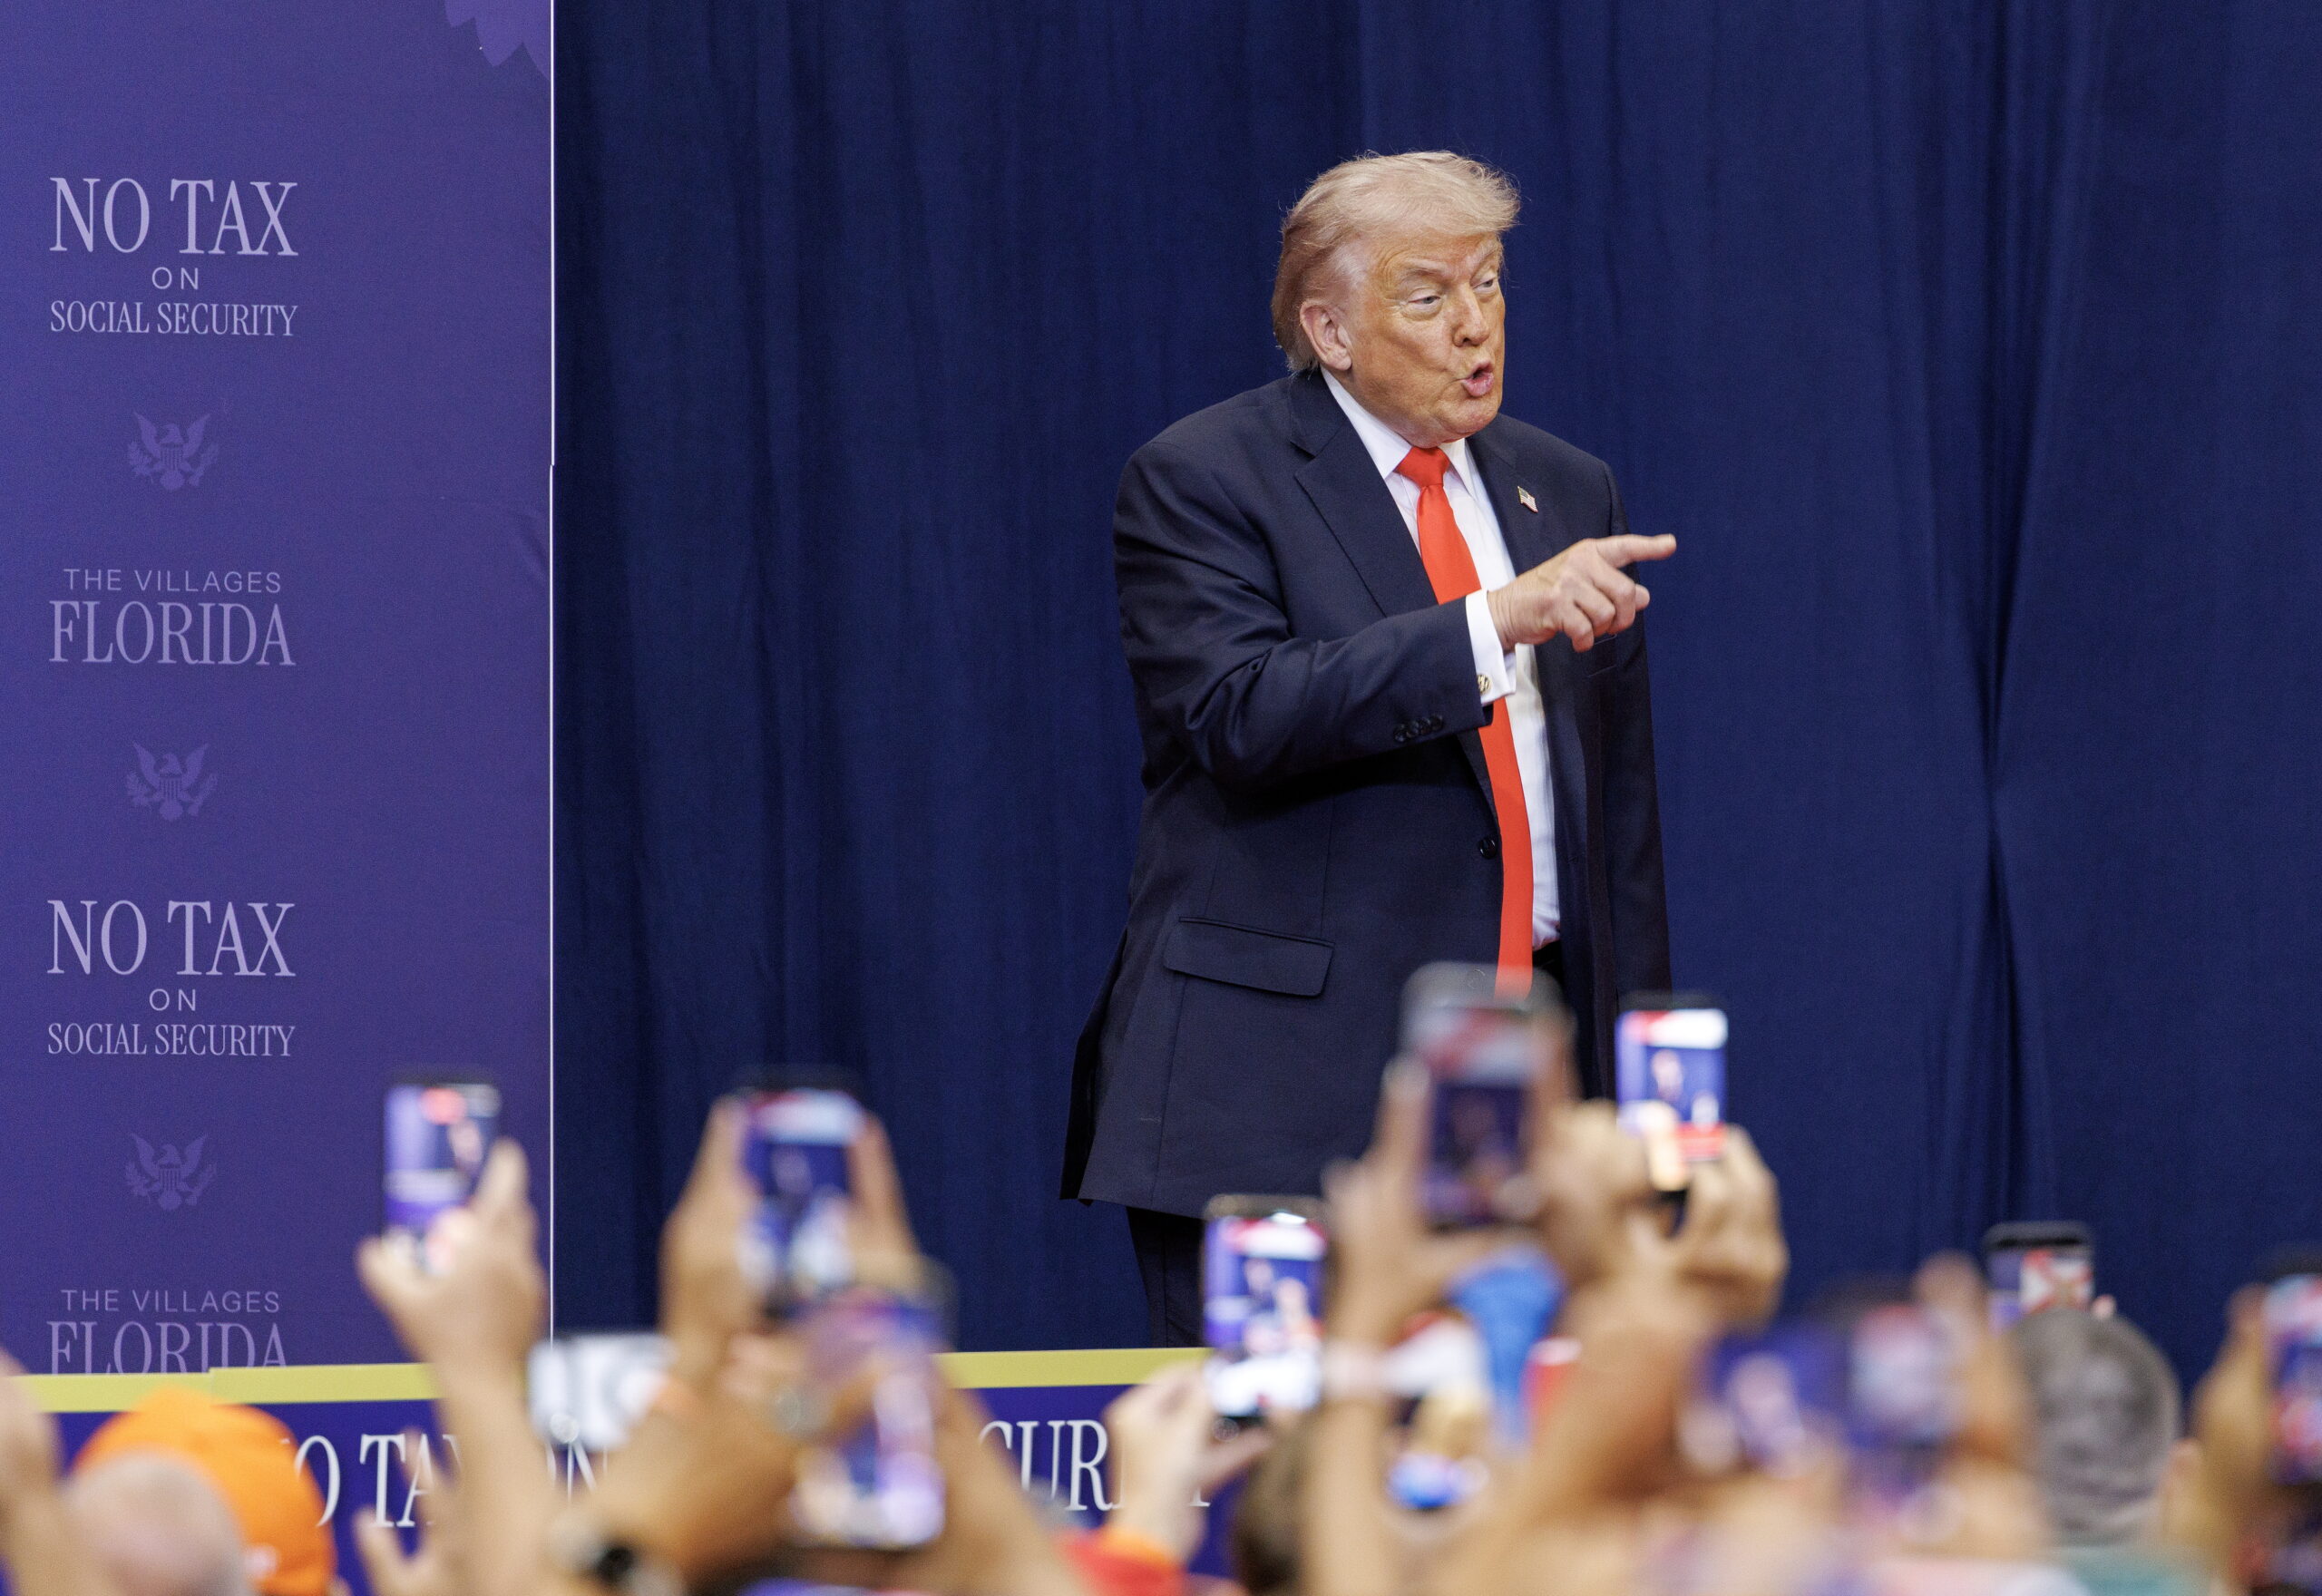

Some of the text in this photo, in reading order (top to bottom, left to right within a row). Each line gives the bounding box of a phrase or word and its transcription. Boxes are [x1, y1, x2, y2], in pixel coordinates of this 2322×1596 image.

[49, 177, 298, 256] NO TAX
[151, 267, 199, 290] ON
[50, 300, 298, 336] SOCIAL SECURITY
[63, 569, 281, 594] THE VILLAGES
[49, 600, 296, 667] FLORIDA
[47, 900, 296, 977] NO TAX
[149, 988, 196, 1012] ON
[48, 1023, 296, 1056] SOCIAL SECURITY
[61, 1289, 280, 1314] THE VILLAGES
[46, 1320, 287, 1374] FLORIDA
[279, 1434, 341, 1527] O
[359, 1433, 463, 1527] TA
